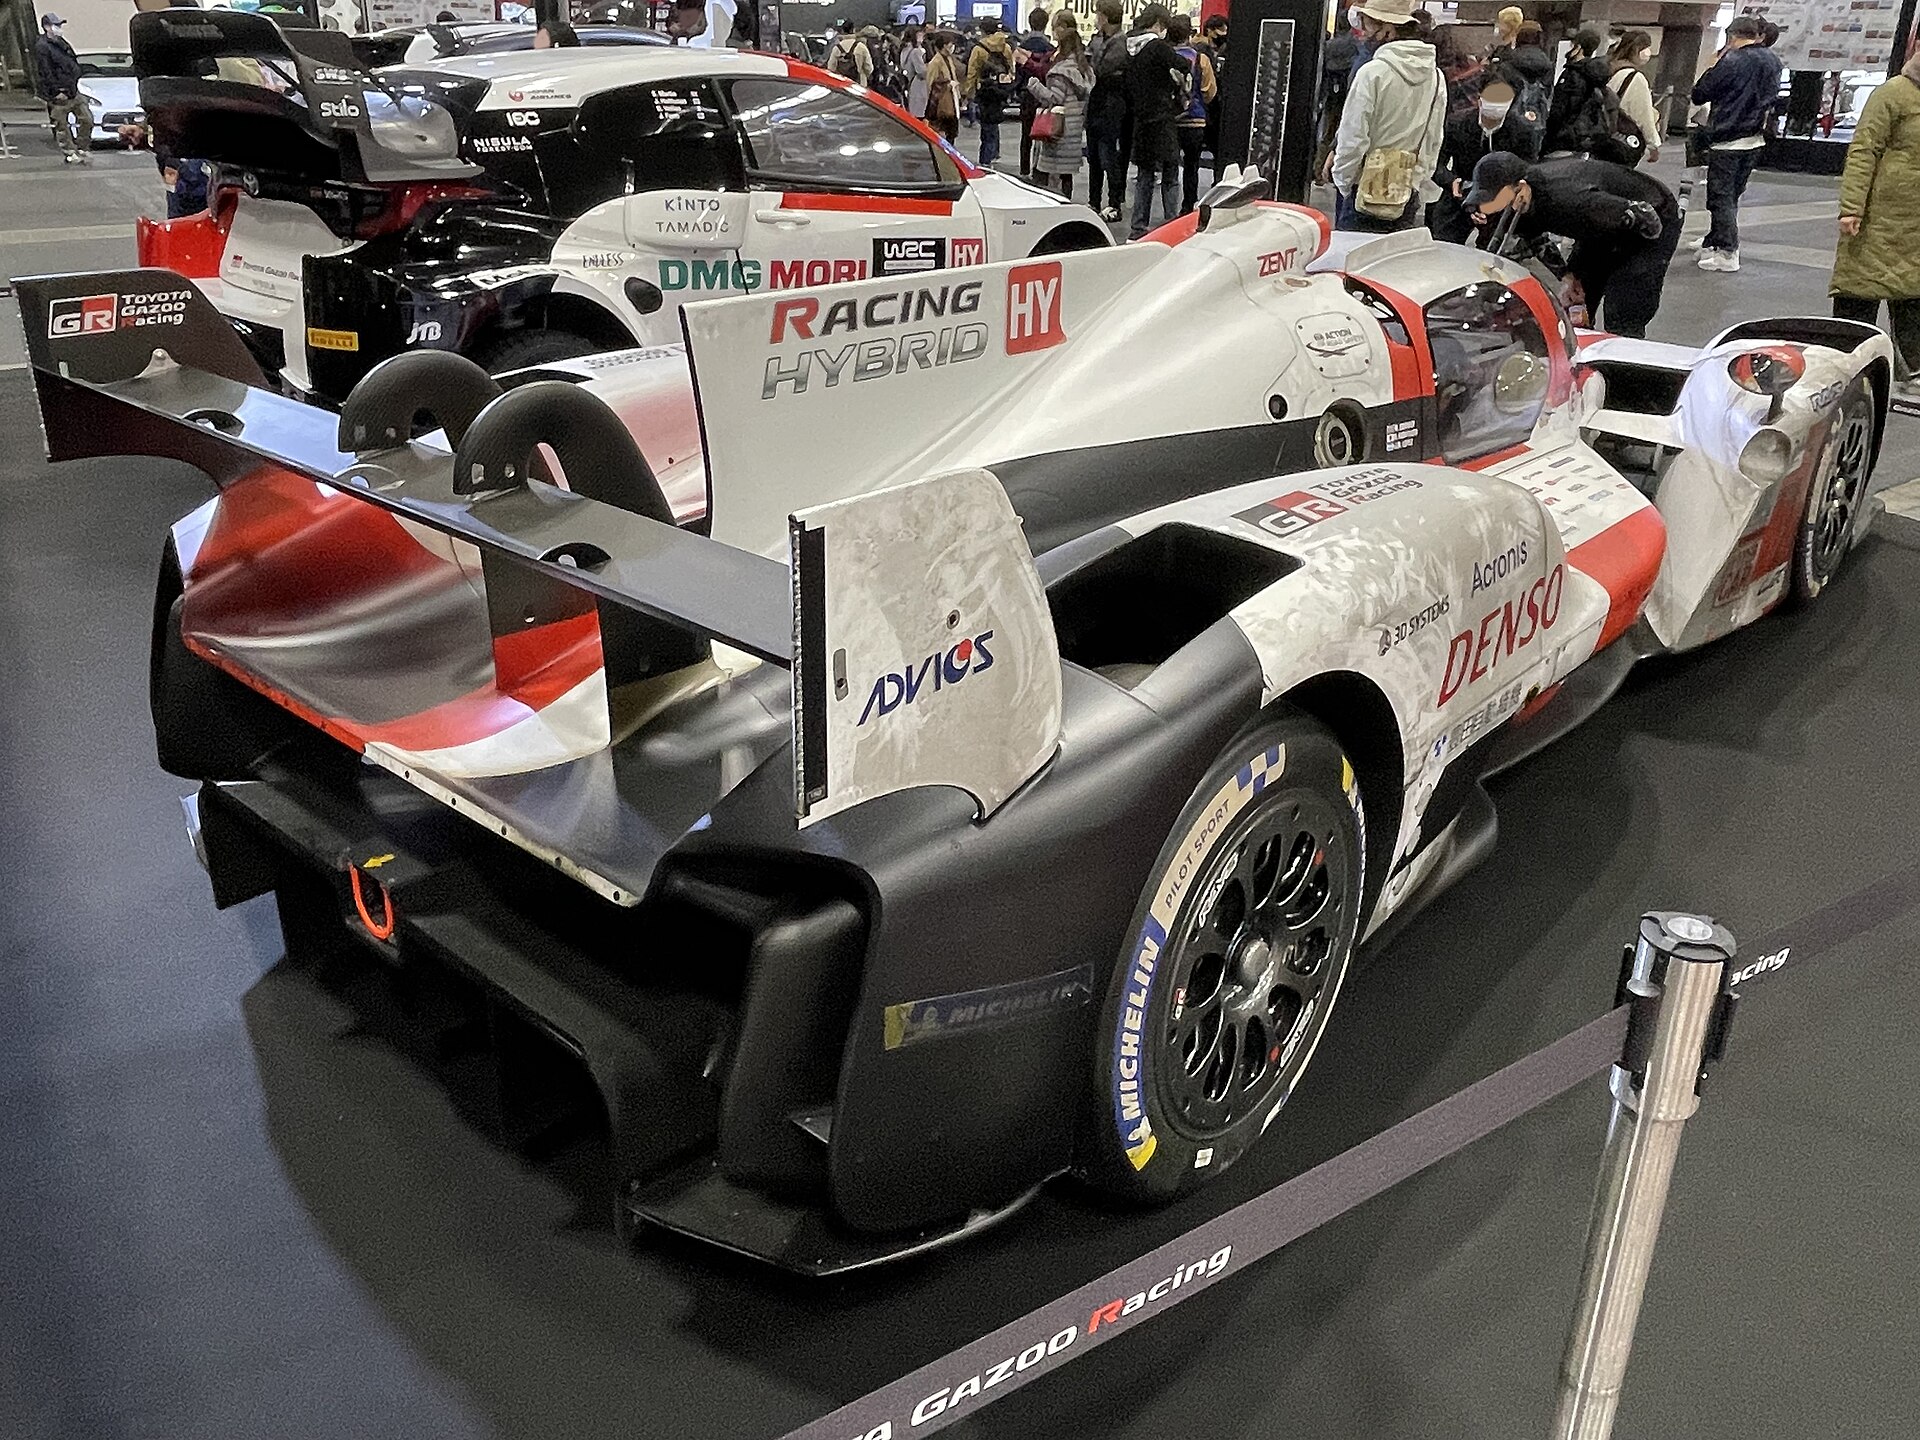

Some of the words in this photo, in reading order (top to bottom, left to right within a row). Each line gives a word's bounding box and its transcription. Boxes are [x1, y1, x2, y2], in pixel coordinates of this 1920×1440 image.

[320, 98, 360, 117] Stilo
[665, 196, 720, 211] KINTO
[655, 221, 729, 233] TAMADIC
[582, 252, 625, 269] ENDLESS
[659, 259, 762, 291] DMG
[769, 259, 867, 290] MORI
[1257, 247, 1297, 277] ZENT
[121, 290, 192, 305] TOYOTA
[121, 301, 186, 317] GAZOO
[769, 281, 984, 345] RACING
[1009, 277, 1058, 340] HY
[53, 309, 113, 334] GR
[120, 313, 185, 328] Racing
[1325, 328, 1352, 340] ACTION
[761, 321, 990, 400] HYBRID
[1308, 467, 1392, 491] TOYOTA
[1329, 473, 1402, 499] GAZOO
[1346, 479, 1424, 505] Racing
[1258, 499, 1344, 536] GR
[1471, 541, 1528, 598] Acronis
[1393, 624, 1407, 646] 3D
[1408, 594, 1450, 636] SYSTEMS
[1437, 563, 1563, 709] DENSO
[856, 630, 994, 727] ADVICS
[1165, 852, 1193, 909] PILOT
[1194, 799, 1230, 853] SPORT
[1730, 947, 1791, 987] acing
[1119, 936, 1160, 1121] MICHELIN
[911, 1325, 1078, 1427] GAZOO
[1088, 1245, 1232, 1334] Racing
